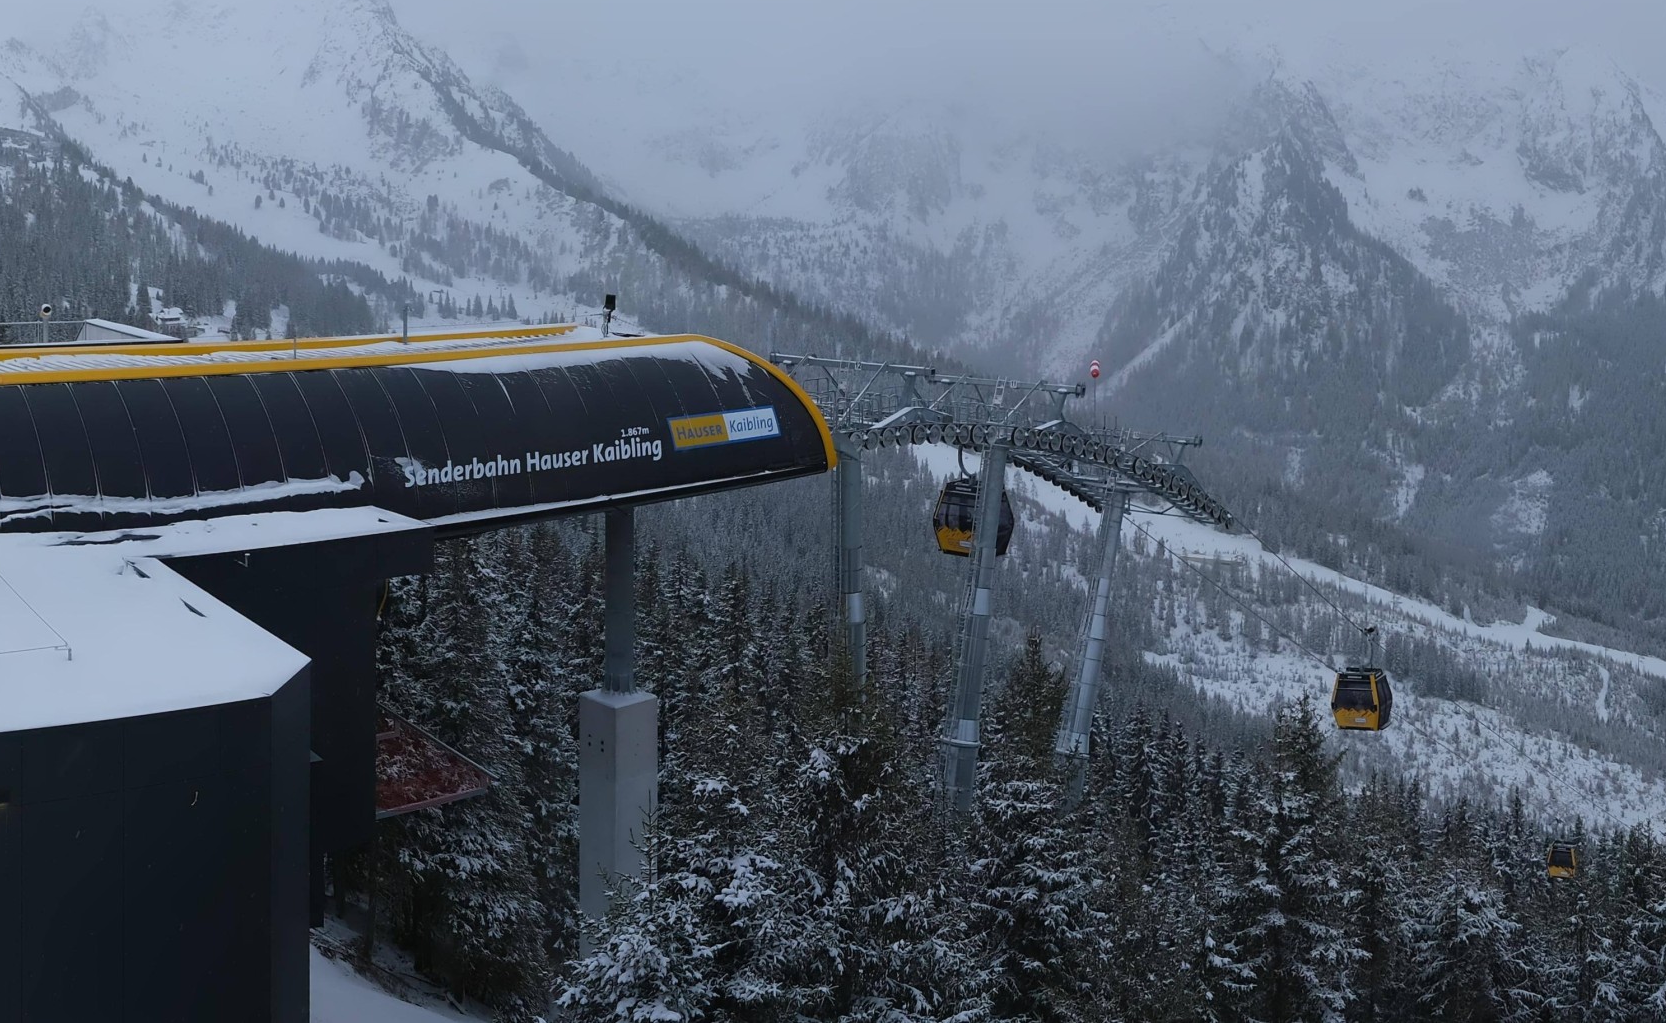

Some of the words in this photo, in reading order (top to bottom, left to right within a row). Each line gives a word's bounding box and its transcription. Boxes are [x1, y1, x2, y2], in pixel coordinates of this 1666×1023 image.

[620, 426, 650, 438] 1.867m
[676, 424, 723, 441] HAUSER
[729, 416, 774, 433] Kaibling
[404, 454, 521, 488] Senderbahn
[526, 449, 589, 473] Hauser
[593, 438, 662, 464] Kaibling
